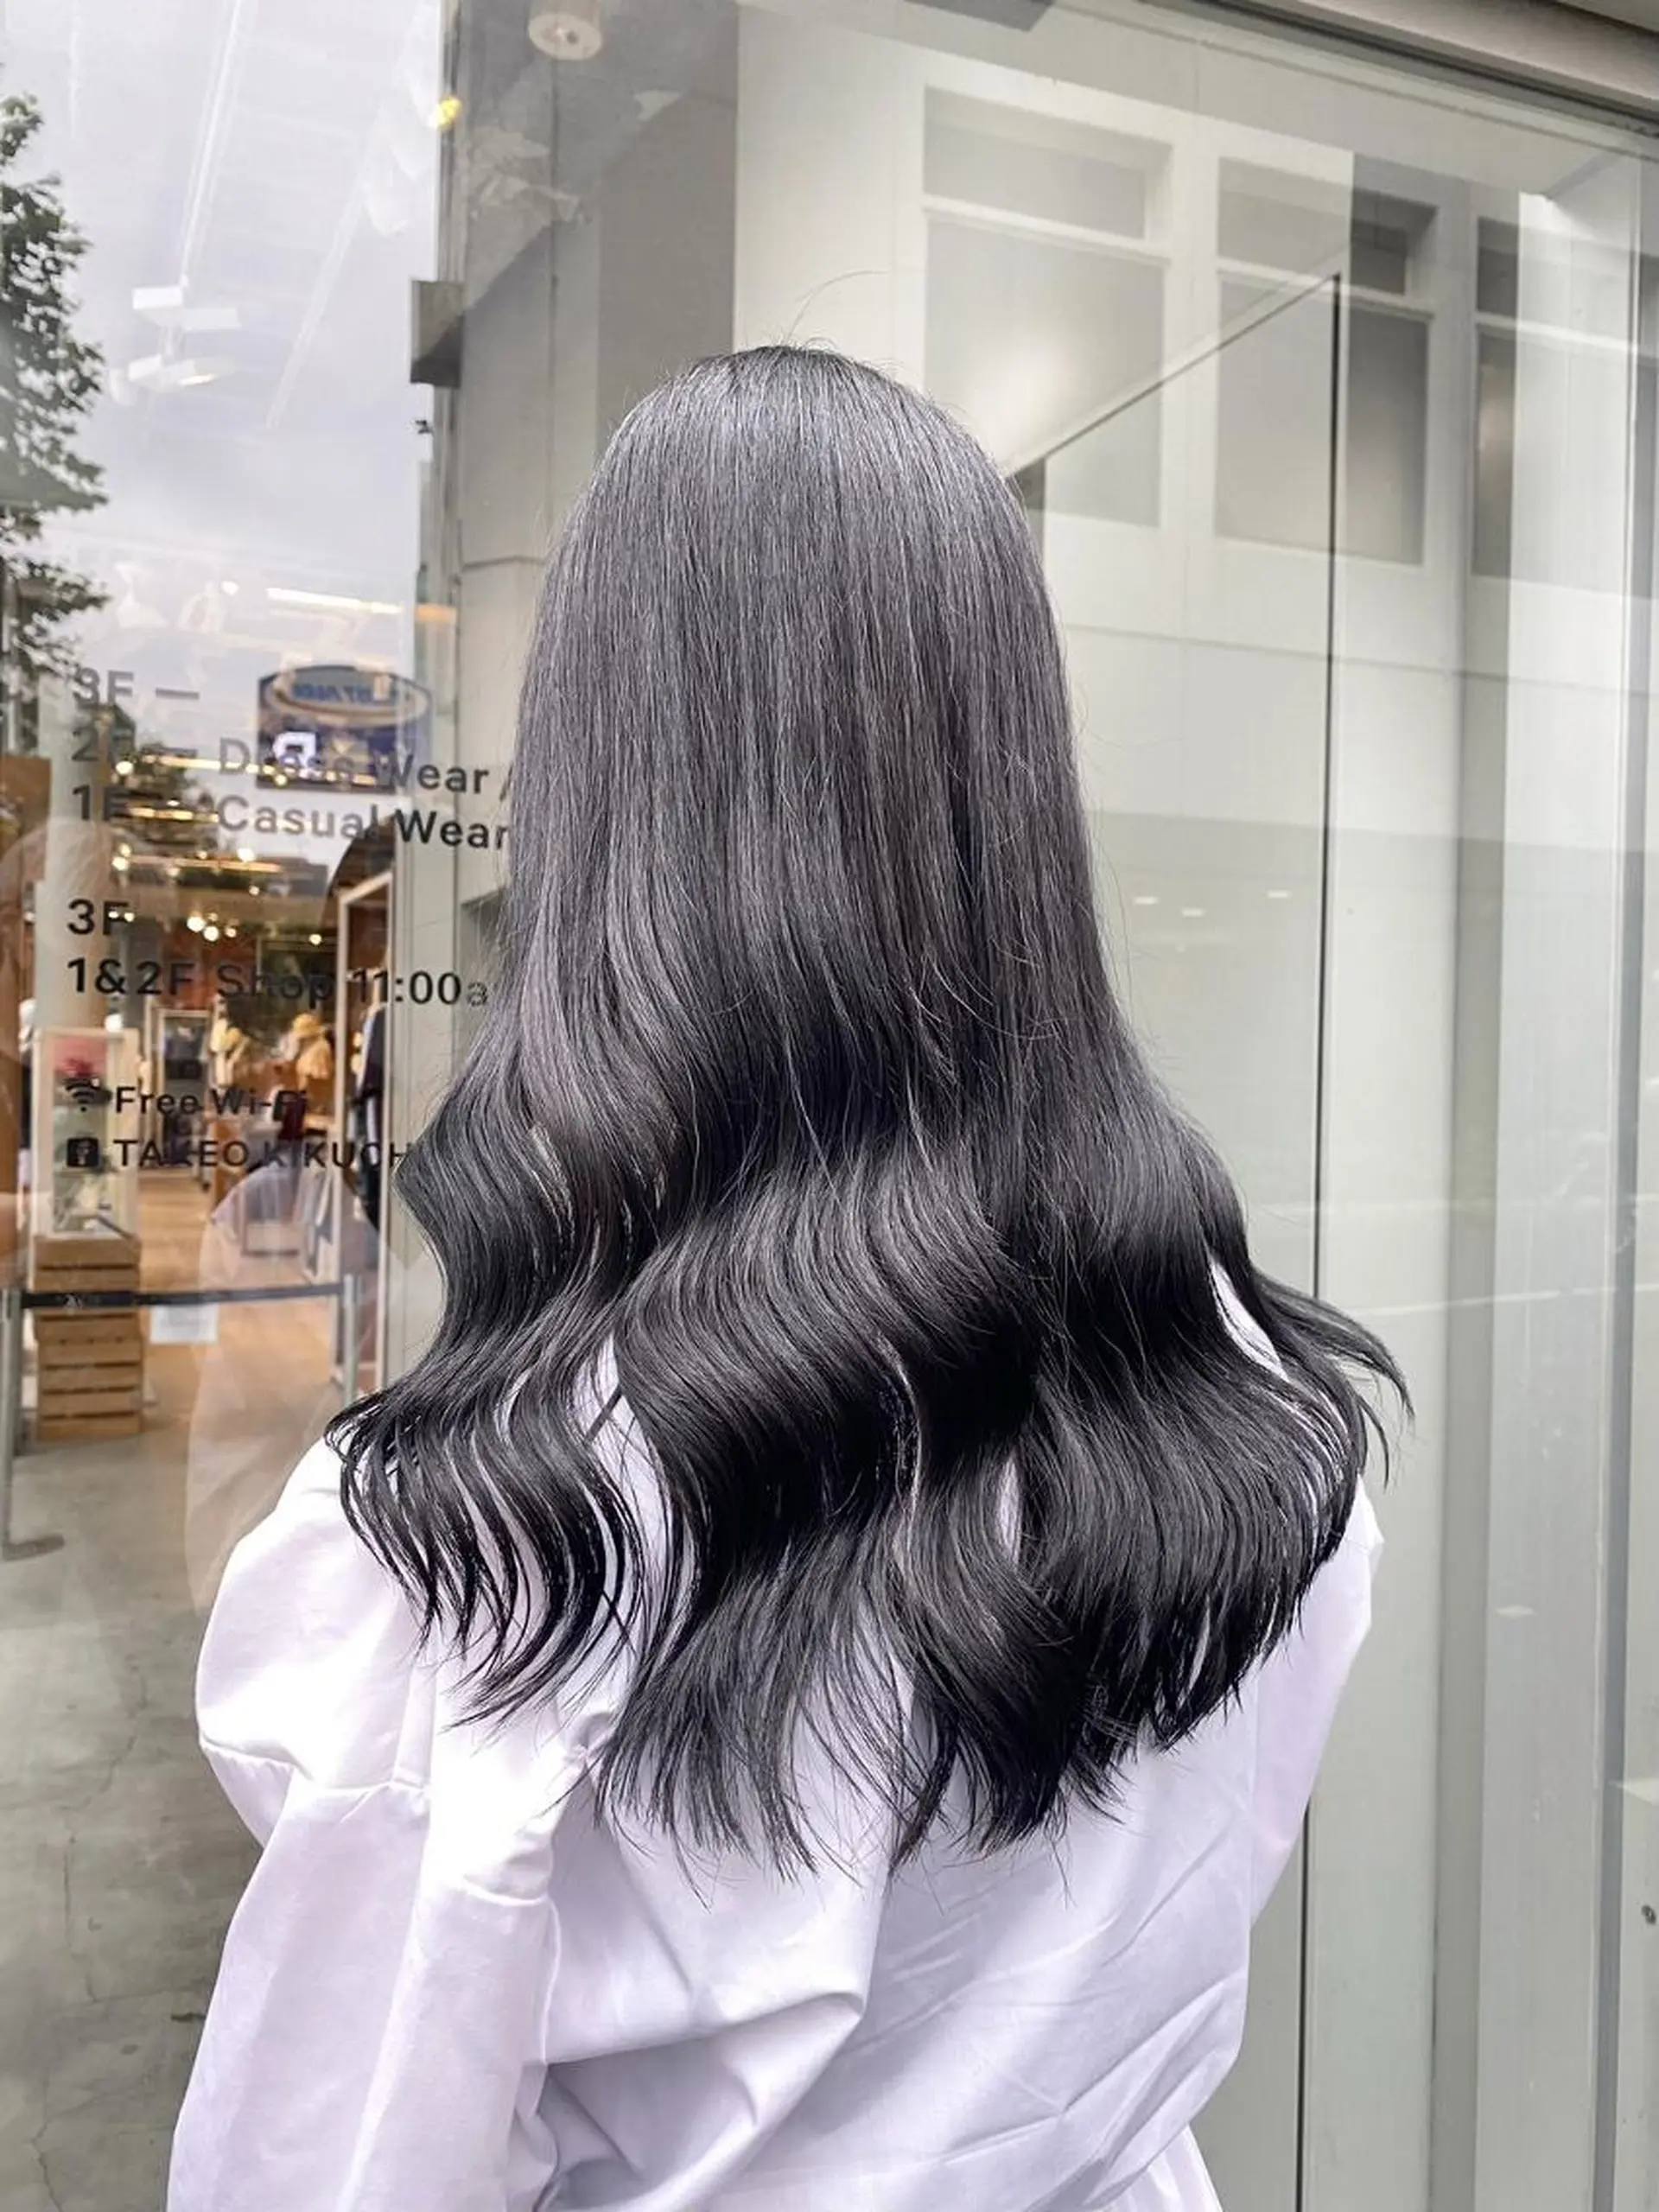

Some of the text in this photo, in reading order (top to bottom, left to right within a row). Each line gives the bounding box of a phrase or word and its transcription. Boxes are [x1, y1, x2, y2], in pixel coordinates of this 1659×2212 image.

[219, 737, 355, 783] Dess
[375, 750, 490, 794] Wear
[217, 795, 379, 841] Casual
[394, 808, 509, 850] Wear
[67, 899, 130, 936] 3F
[216, 963, 335, 1009] Shop
[115, 1086, 309, 1118] Free Wi-Fi
[113, 1138, 250, 1167] TAKEO
